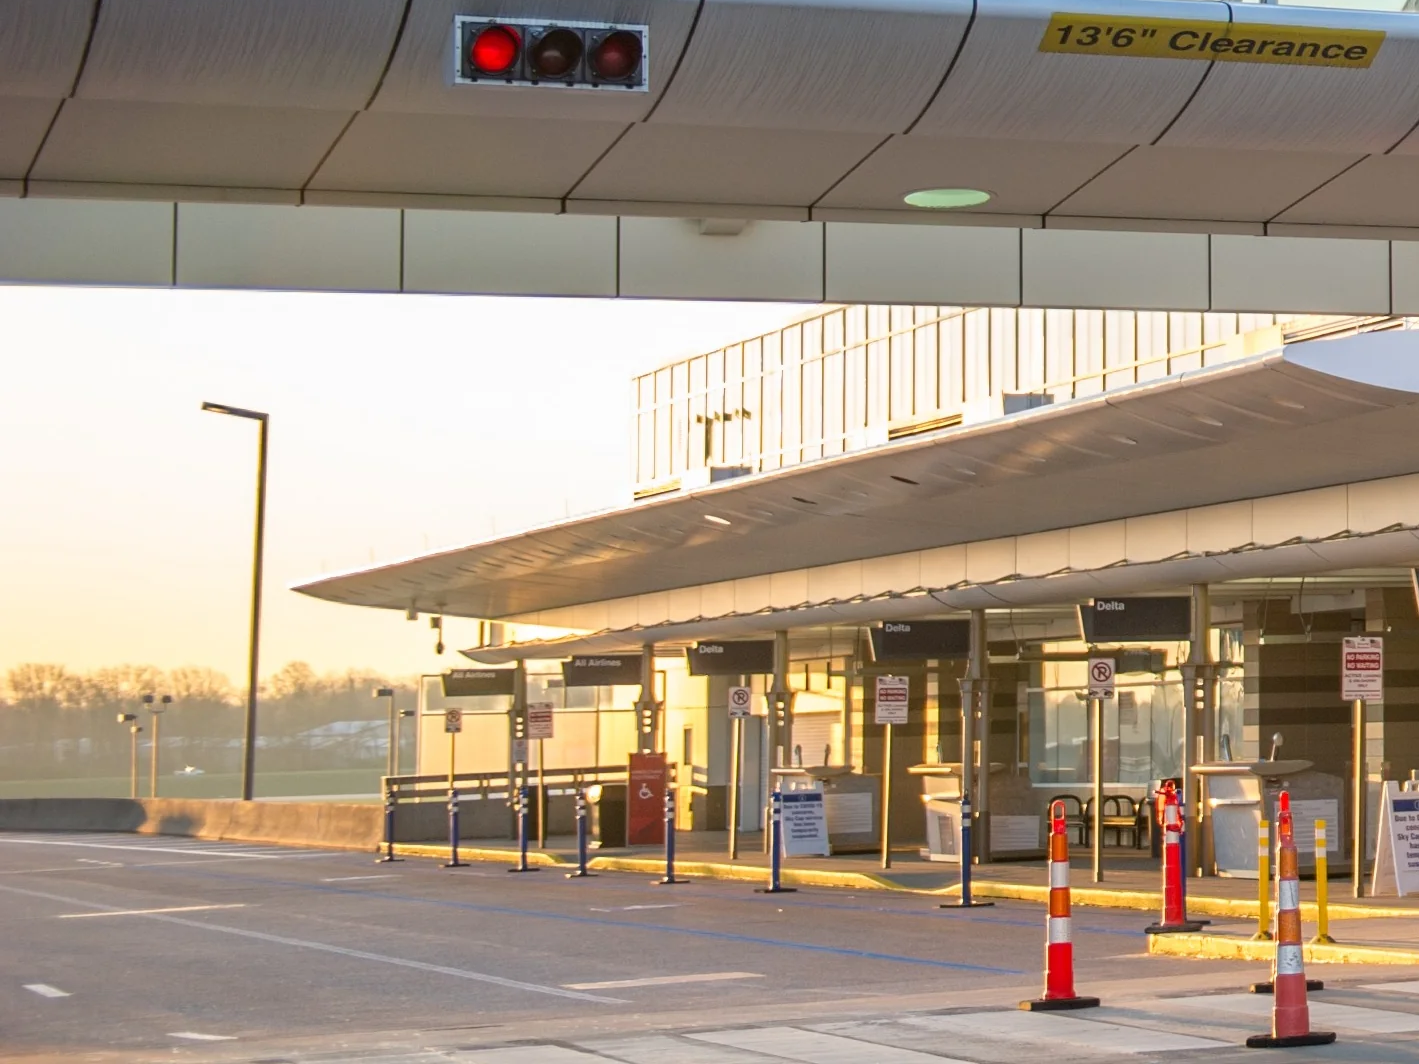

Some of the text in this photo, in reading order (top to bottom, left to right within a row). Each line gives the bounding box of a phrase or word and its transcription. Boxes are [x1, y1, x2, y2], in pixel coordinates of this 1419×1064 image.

[1056, 24, 1368, 61] 13'6" Clearance
[1096, 601, 1125, 611] Delta
[885, 624, 911, 632] Delta
[699, 645, 724, 654] Delta
[574, 658, 622, 668] All Airlines
